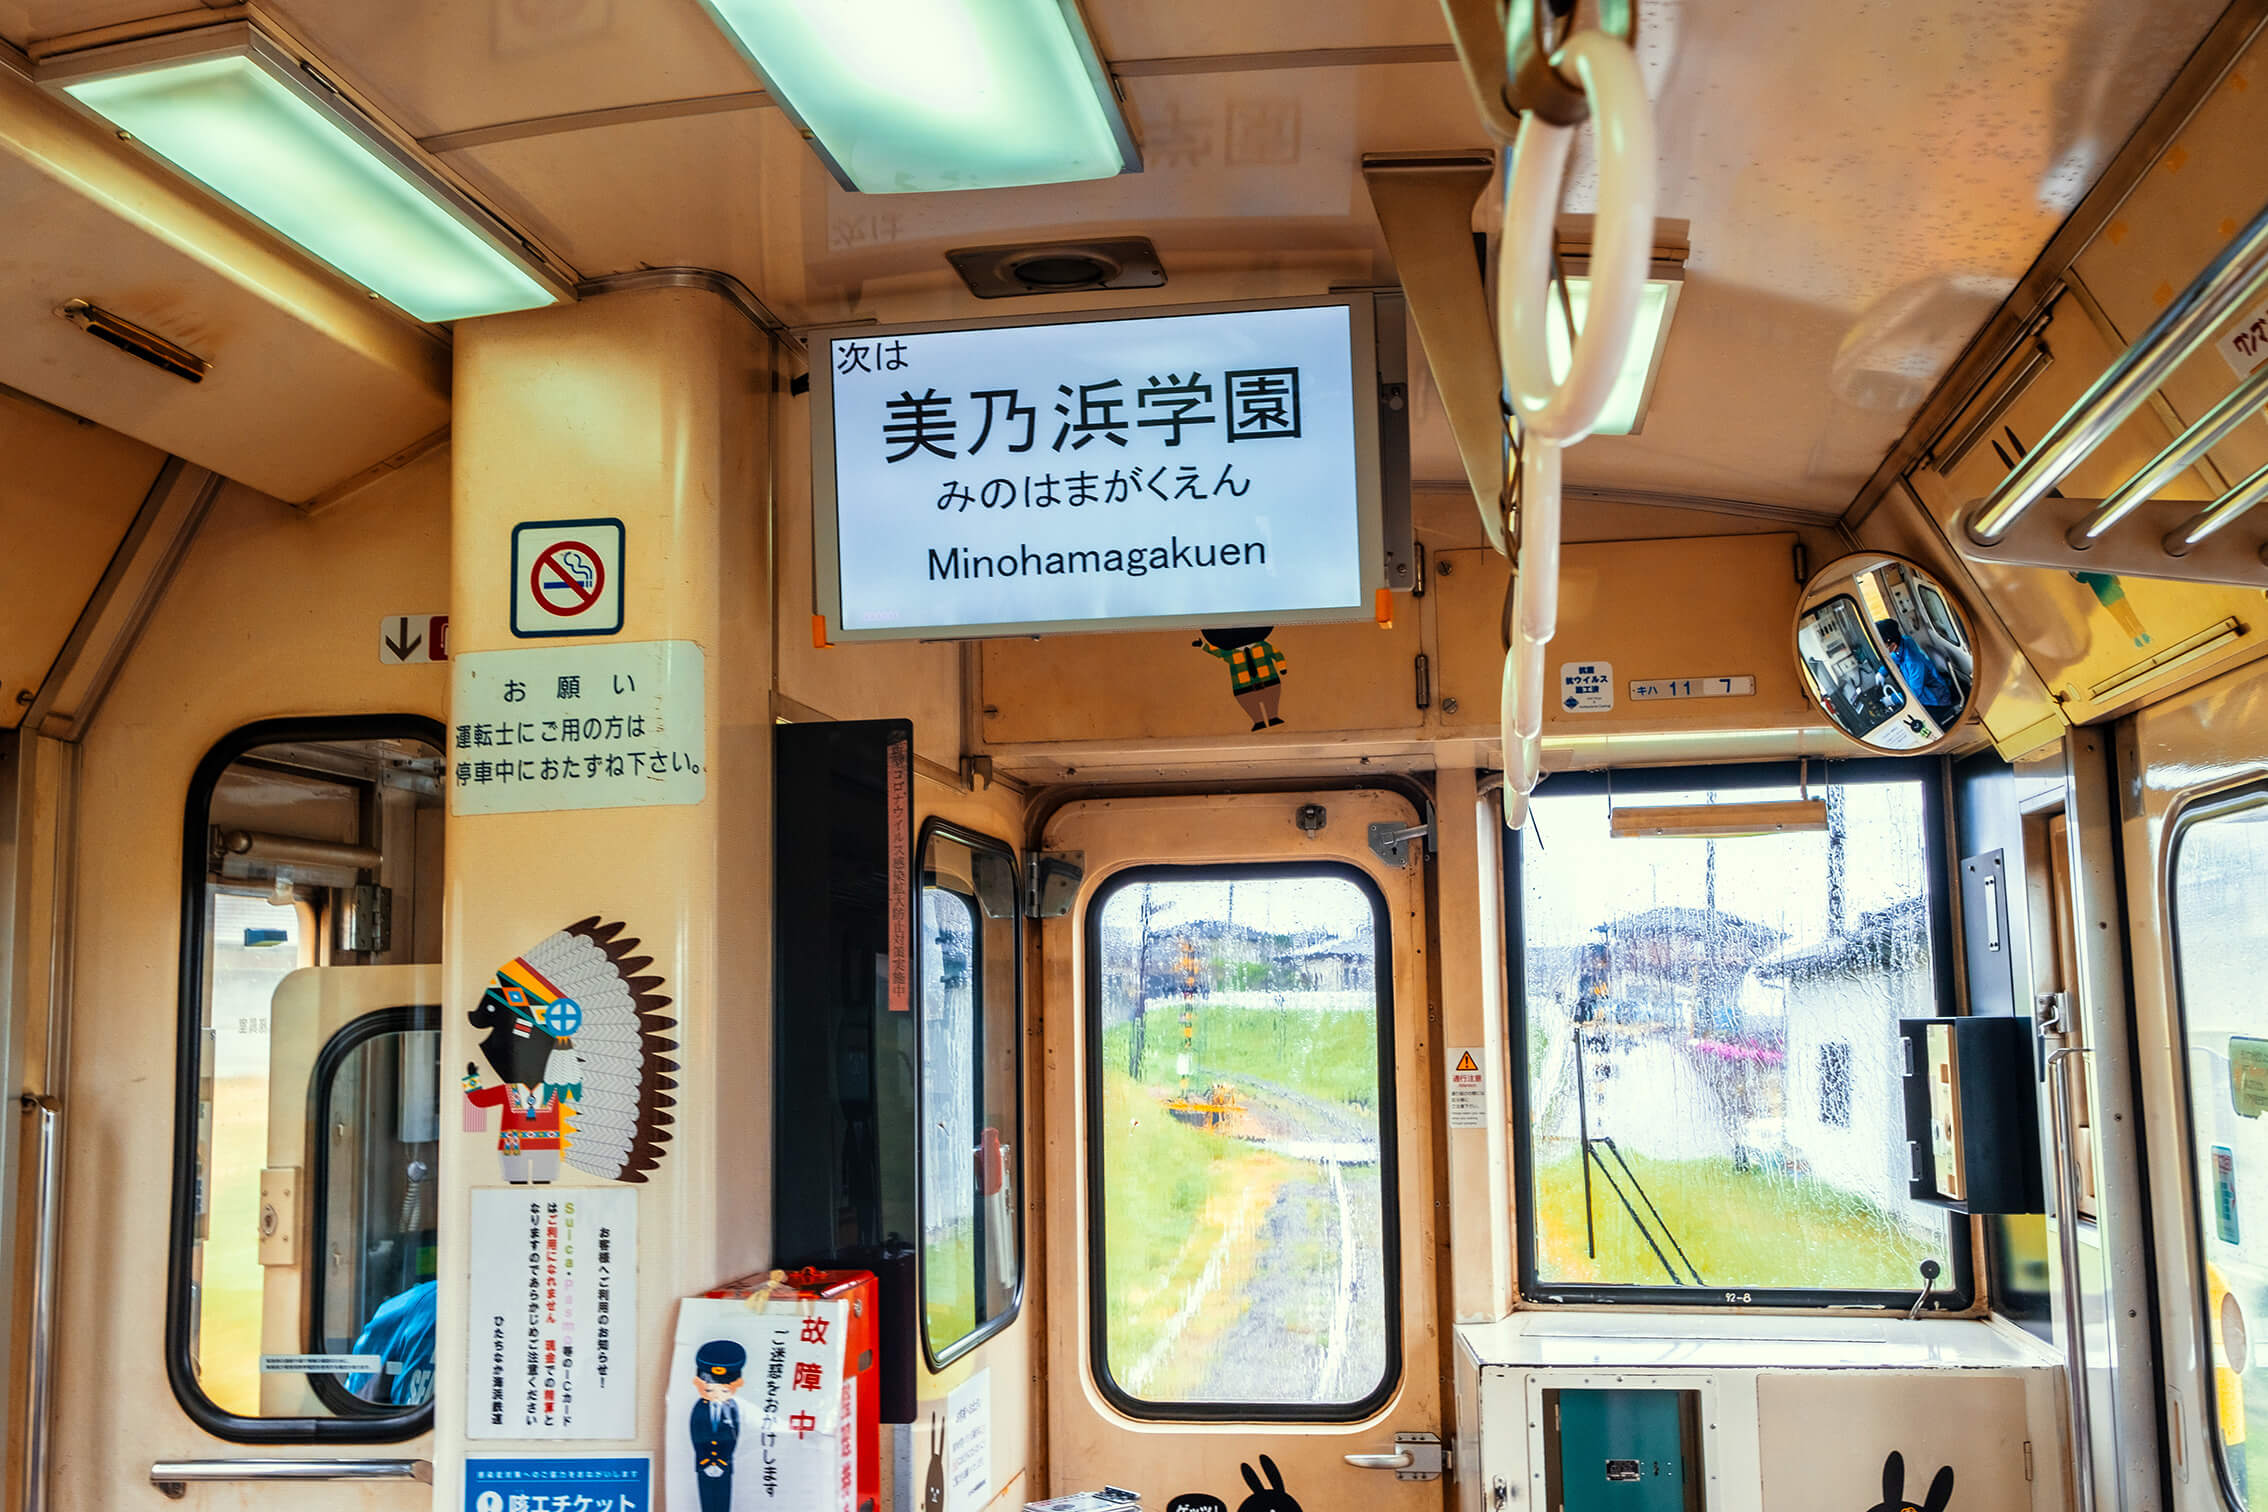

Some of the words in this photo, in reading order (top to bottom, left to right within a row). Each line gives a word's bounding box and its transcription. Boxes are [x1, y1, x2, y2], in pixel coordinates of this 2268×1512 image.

[837, 339, 910, 375] 次は
[882, 366, 1302, 464] 美乃浜学園
[936, 463, 1251, 512] みのはまがくえん
[927, 536, 1267, 583] Minohamagakuen
[503, 673, 636, 703] お願い
[1636, 685, 1659, 696] キハ
[455, 714, 646, 750] 運転士にご用の方は
[455, 751, 701, 787] 停車中におたずね下さい。
[788, 1316, 831, 1440] 故障中
